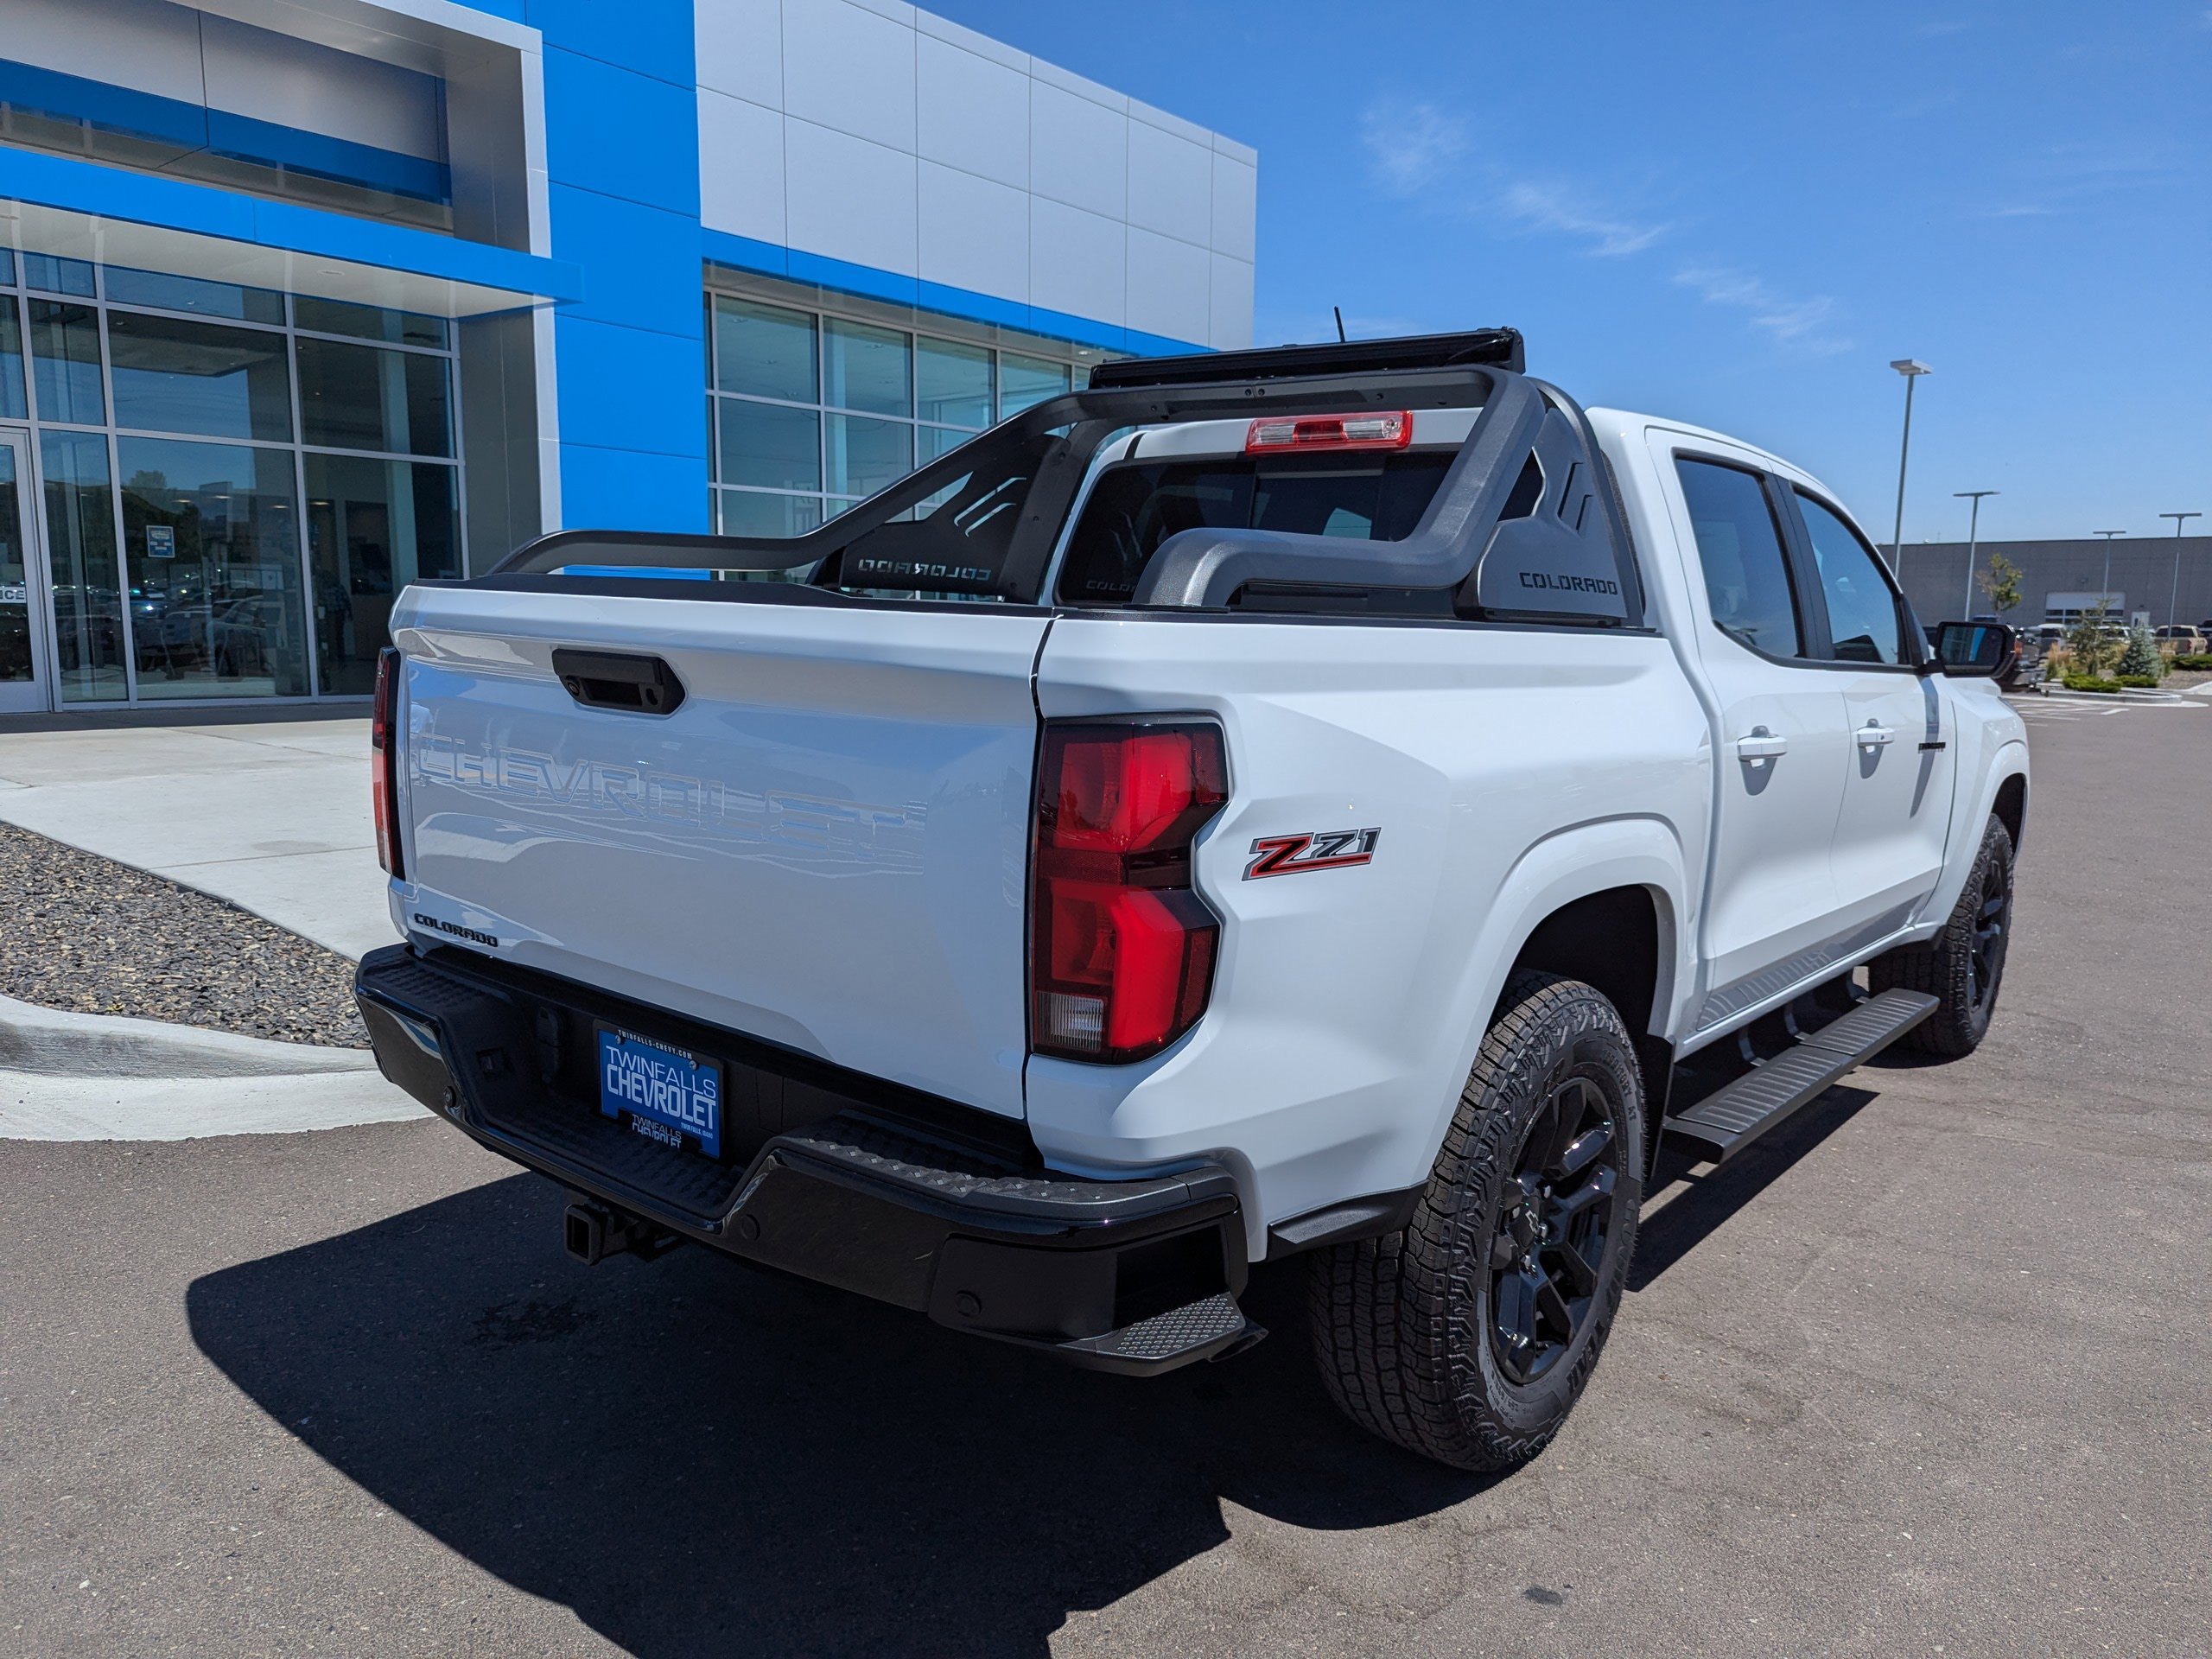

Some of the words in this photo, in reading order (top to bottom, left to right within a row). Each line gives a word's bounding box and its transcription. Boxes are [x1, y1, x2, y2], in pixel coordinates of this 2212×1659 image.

[1519, 572, 1618, 595] COLORADO
[414, 733, 907, 860] CHEVROLET
[1242, 827, 1382, 881] Z71
[414, 912, 499, 948] COLORADO
[617, 1028, 693, 1060] TWINFALLS-CHEVY.COM
[605, 1046, 716, 1099] TWINFALLS
[607, 1063, 716, 1130] CHEVROLET
[632, 1114, 682, 1141] TWINFALLS
